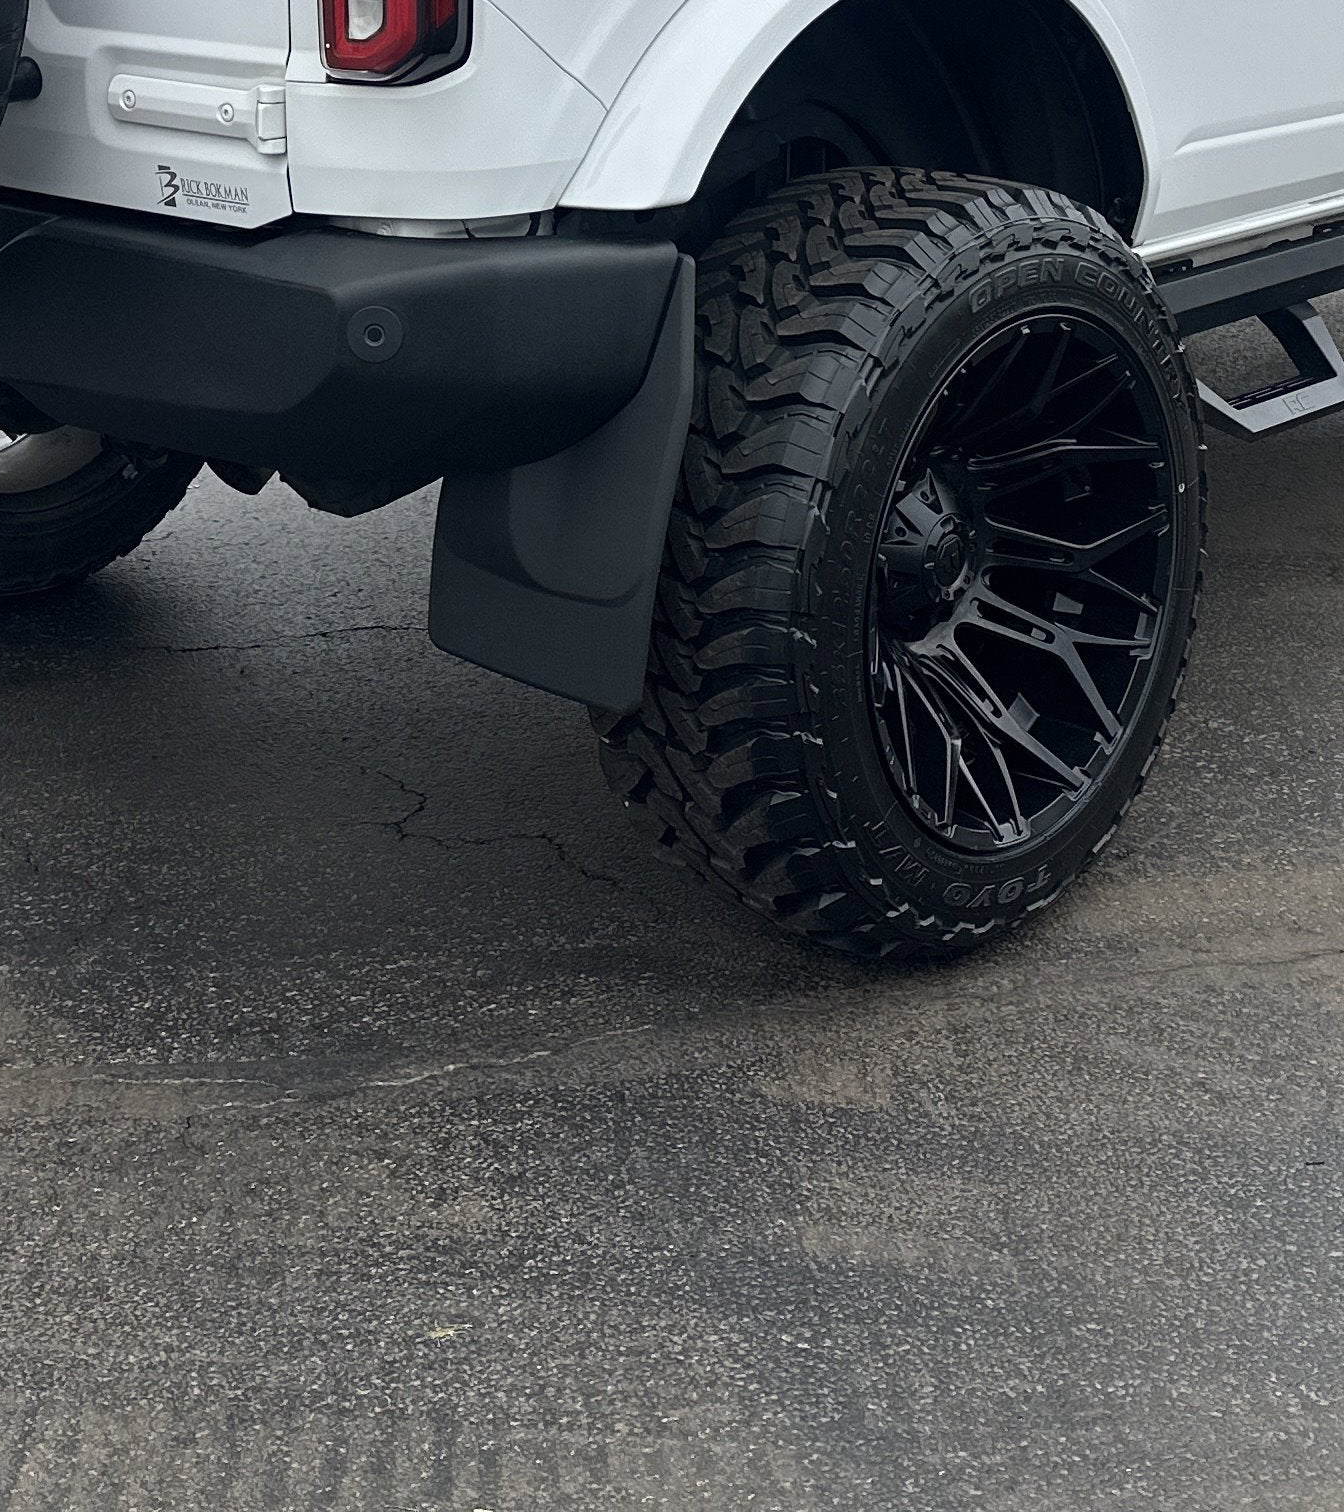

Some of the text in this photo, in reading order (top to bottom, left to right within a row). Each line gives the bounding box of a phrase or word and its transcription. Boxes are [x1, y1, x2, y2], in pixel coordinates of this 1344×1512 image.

[180, 178, 249, 202] RICK BOKMAN
[211, 203, 227, 211] NEW
[228, 205, 248, 214] YORK
[968, 256, 1066, 315] OPEN
[1074, 261, 1185, 406] COUNTRY
[862, 820, 931, 889] M/T
[941, 863, 1053, 910] TOYO
